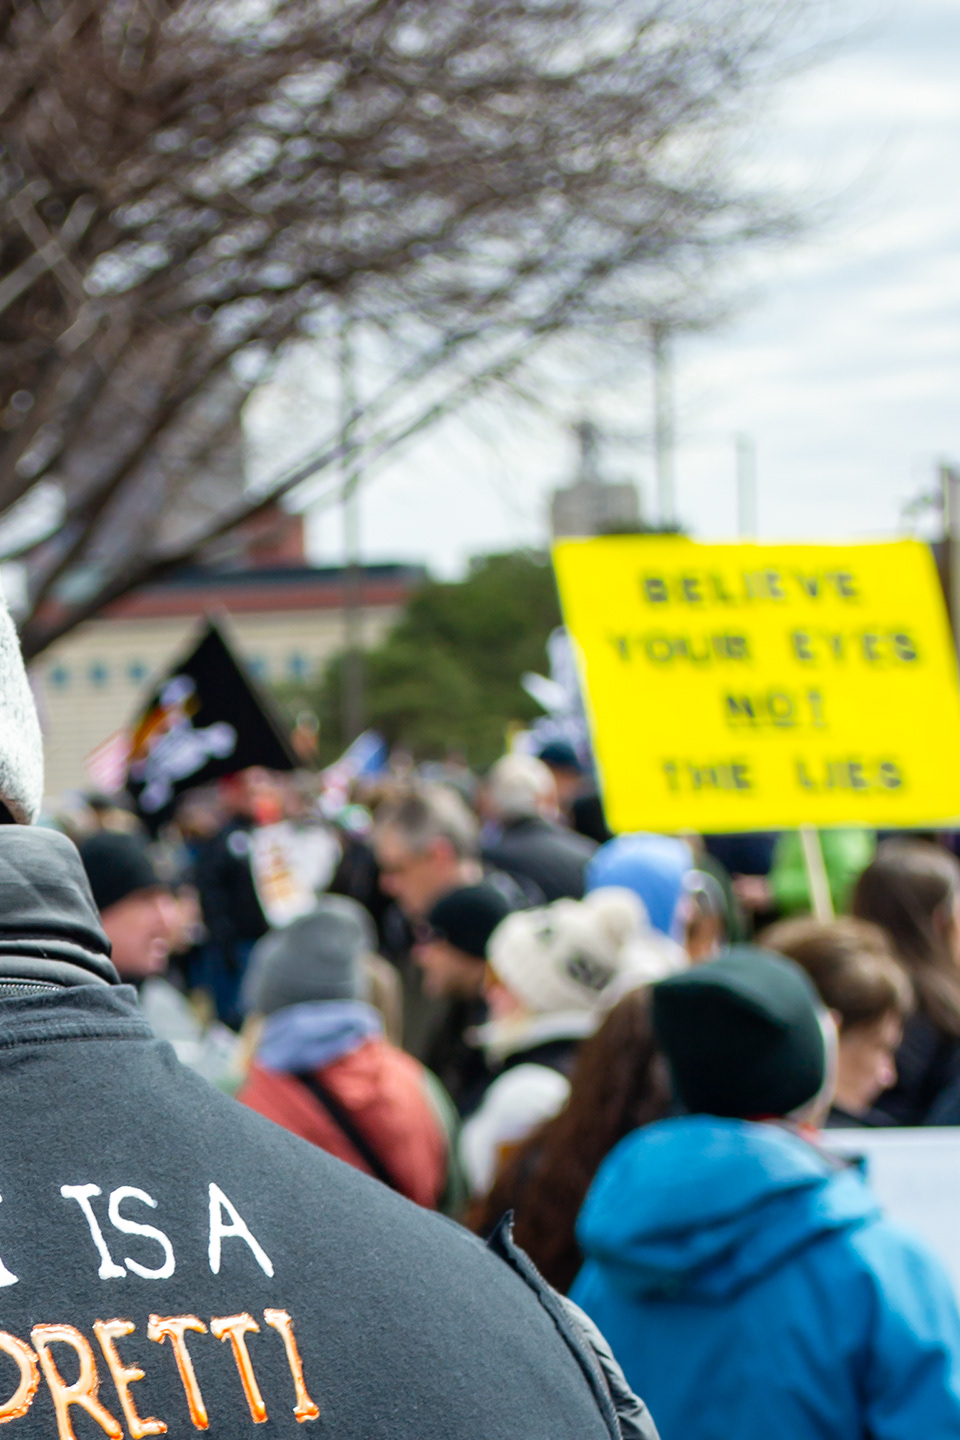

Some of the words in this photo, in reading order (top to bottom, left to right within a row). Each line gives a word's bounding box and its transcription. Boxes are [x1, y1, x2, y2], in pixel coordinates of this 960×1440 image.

[642, 569, 859, 604] BELIEVE
[609, 629, 749, 665] YOUR
[790, 628, 918, 664] EYES
[660, 757, 753, 794] THE
[793, 757, 905, 792] LIES
[60, 1182, 177, 1281] IS
[208, 1181, 275, 1279] A
